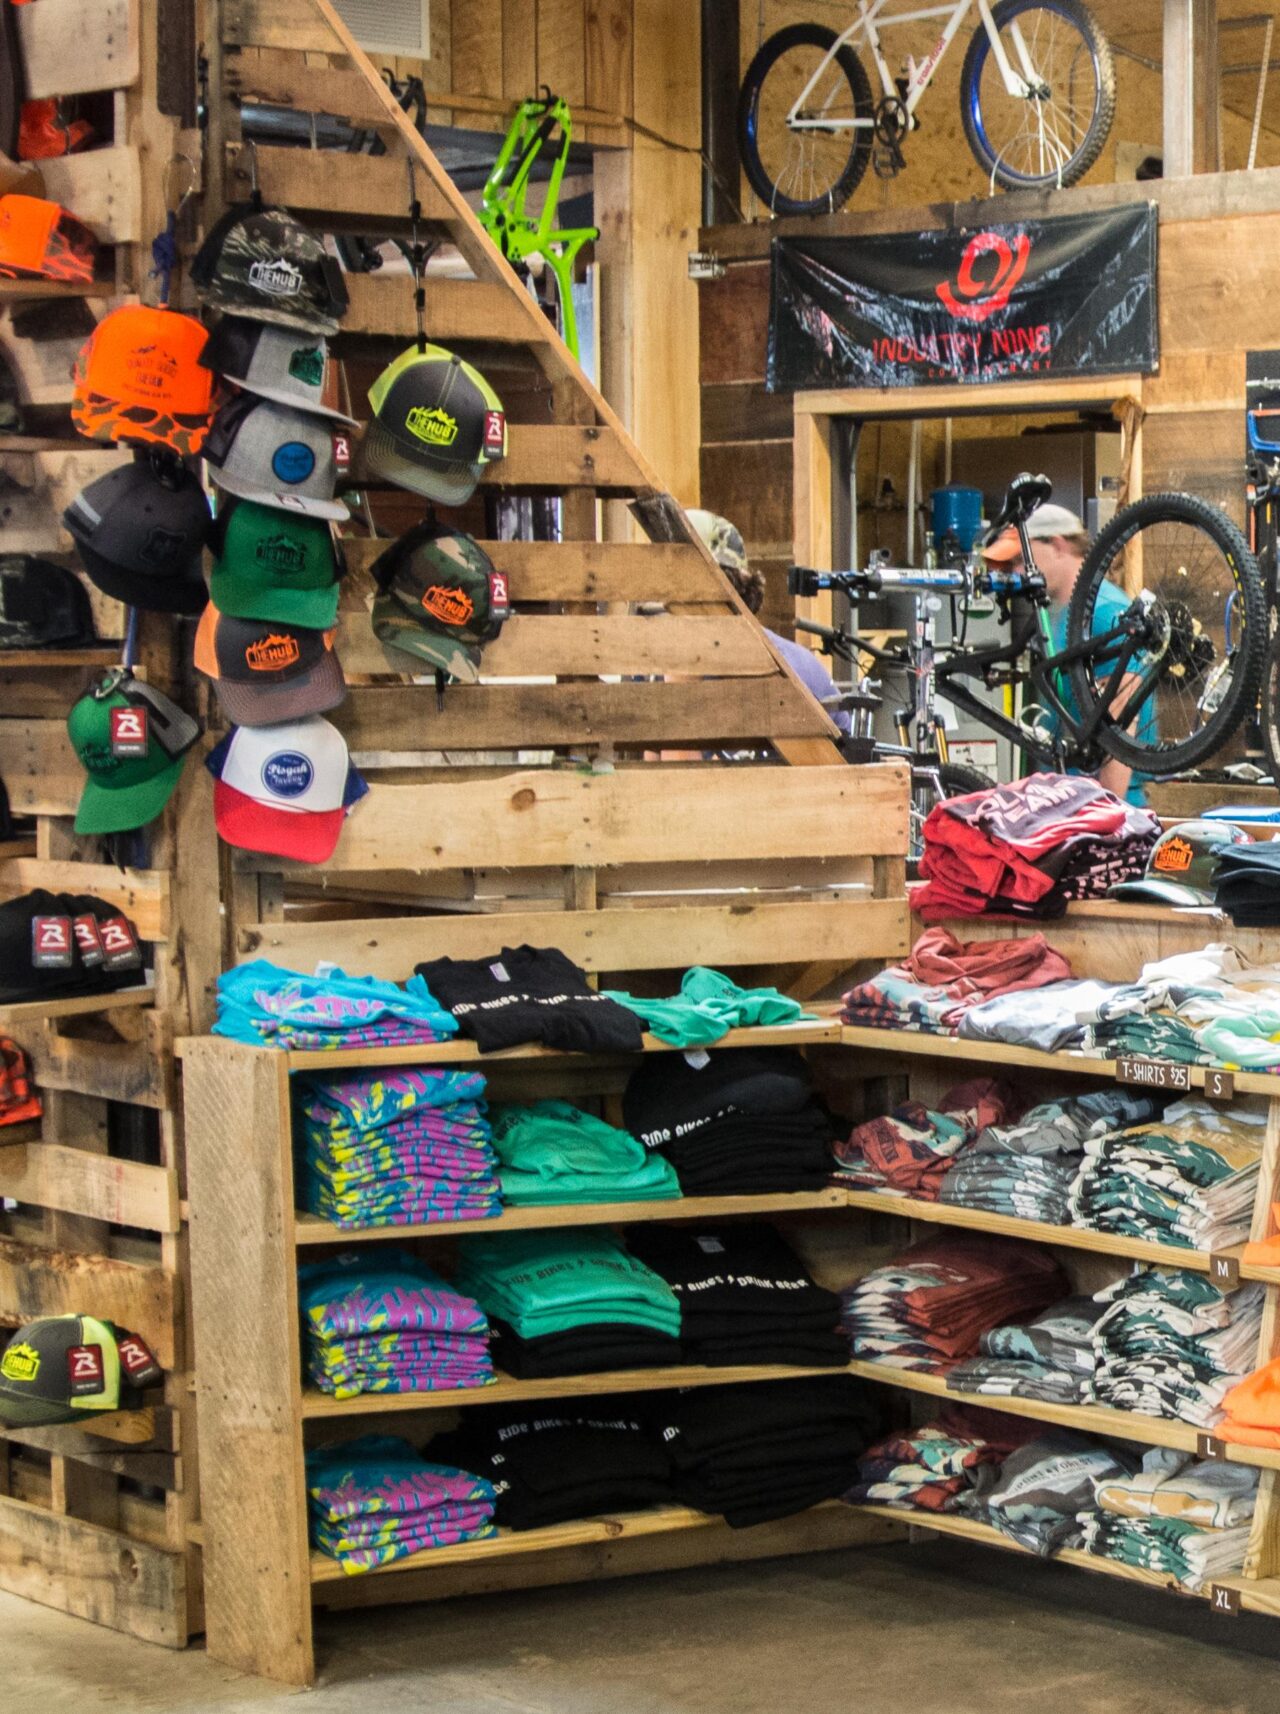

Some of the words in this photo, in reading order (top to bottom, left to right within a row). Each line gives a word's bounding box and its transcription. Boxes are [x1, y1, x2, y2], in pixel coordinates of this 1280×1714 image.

[273, 267, 297, 287] HUB
[991, 324, 1051, 356] NINE
[428, 416, 452, 437] HUB
[446, 597, 467, 618] HUB
[268, 641, 294, 660] HUB
[267, 762, 308, 777] Pisgah
[1122, 1061, 1167, 1086] T-SHIRTS
[1170, 1066, 1187, 1087] $25
[1213, 1073, 1222, 1095] S
[1217, 1260, 1230, 1278] M
[1206, 1438, 1217, 1457] L
[1215, 1589, 1232, 1611] XL
